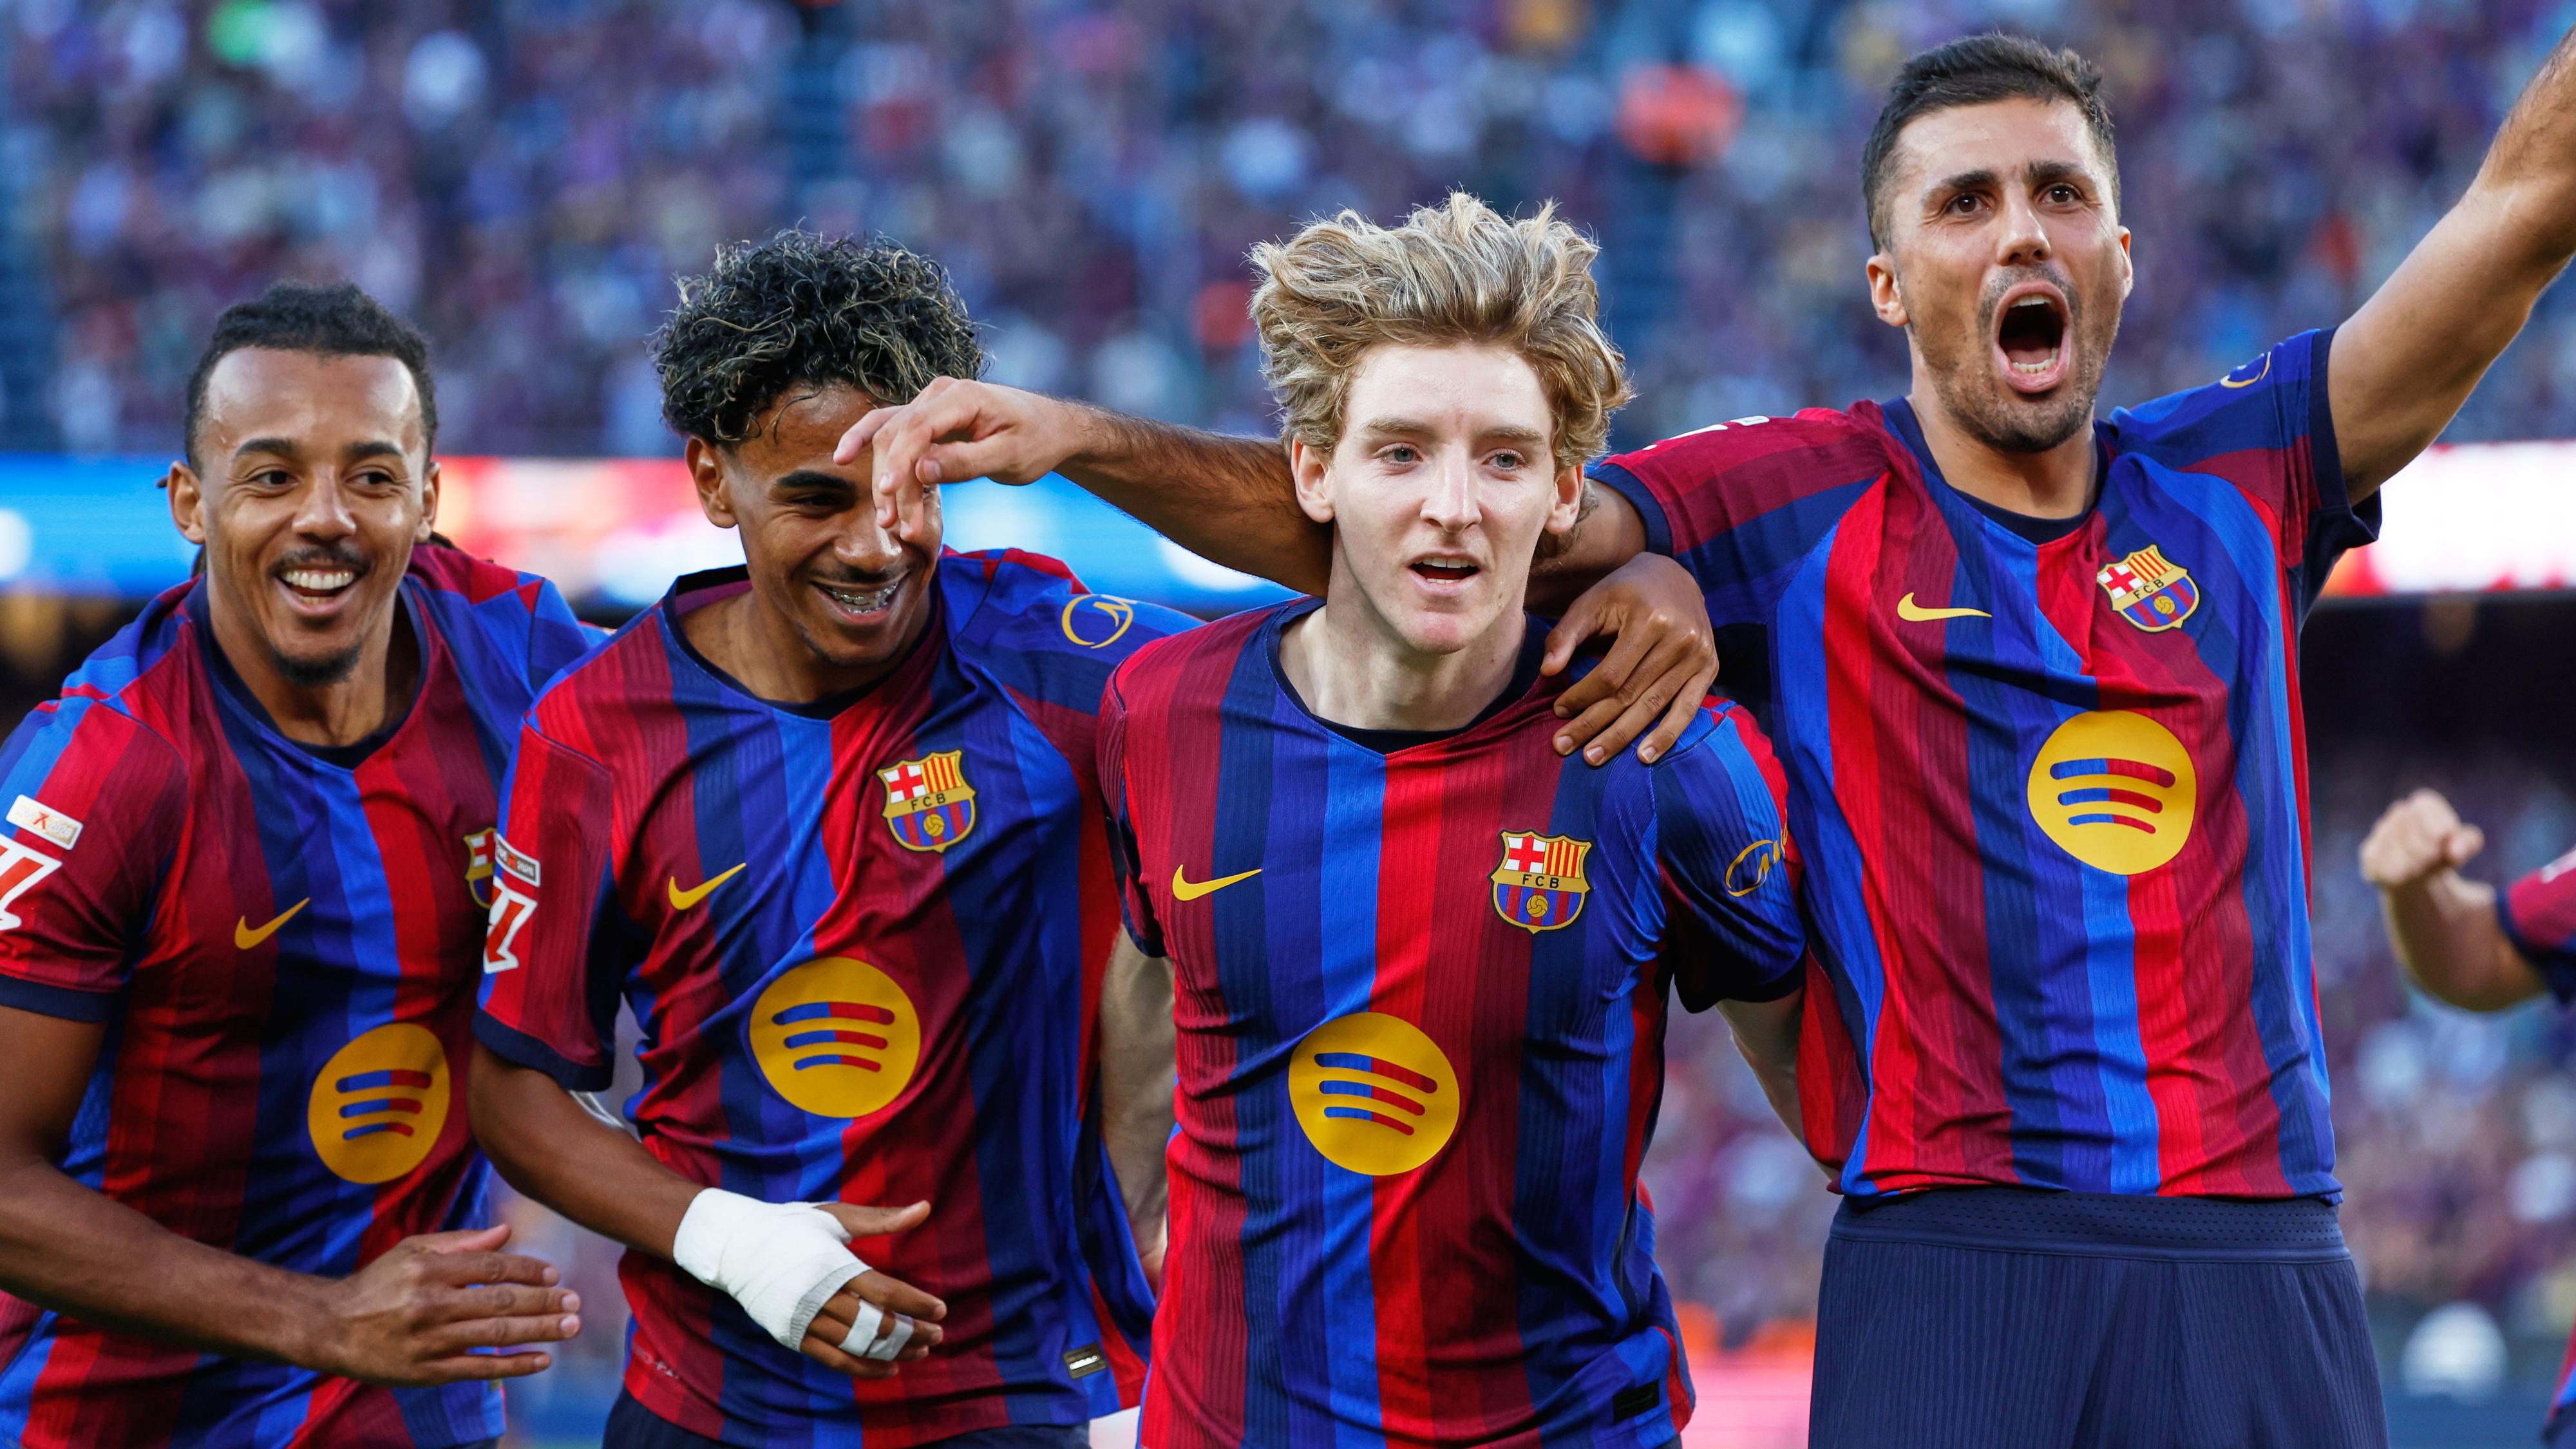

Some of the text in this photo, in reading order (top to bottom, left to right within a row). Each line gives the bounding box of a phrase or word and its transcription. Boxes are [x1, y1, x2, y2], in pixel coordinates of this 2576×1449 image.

[2133, 579, 2164, 599] FCB
[911, 793, 946, 811] FCB
[1522, 873, 1560, 889] FCB
